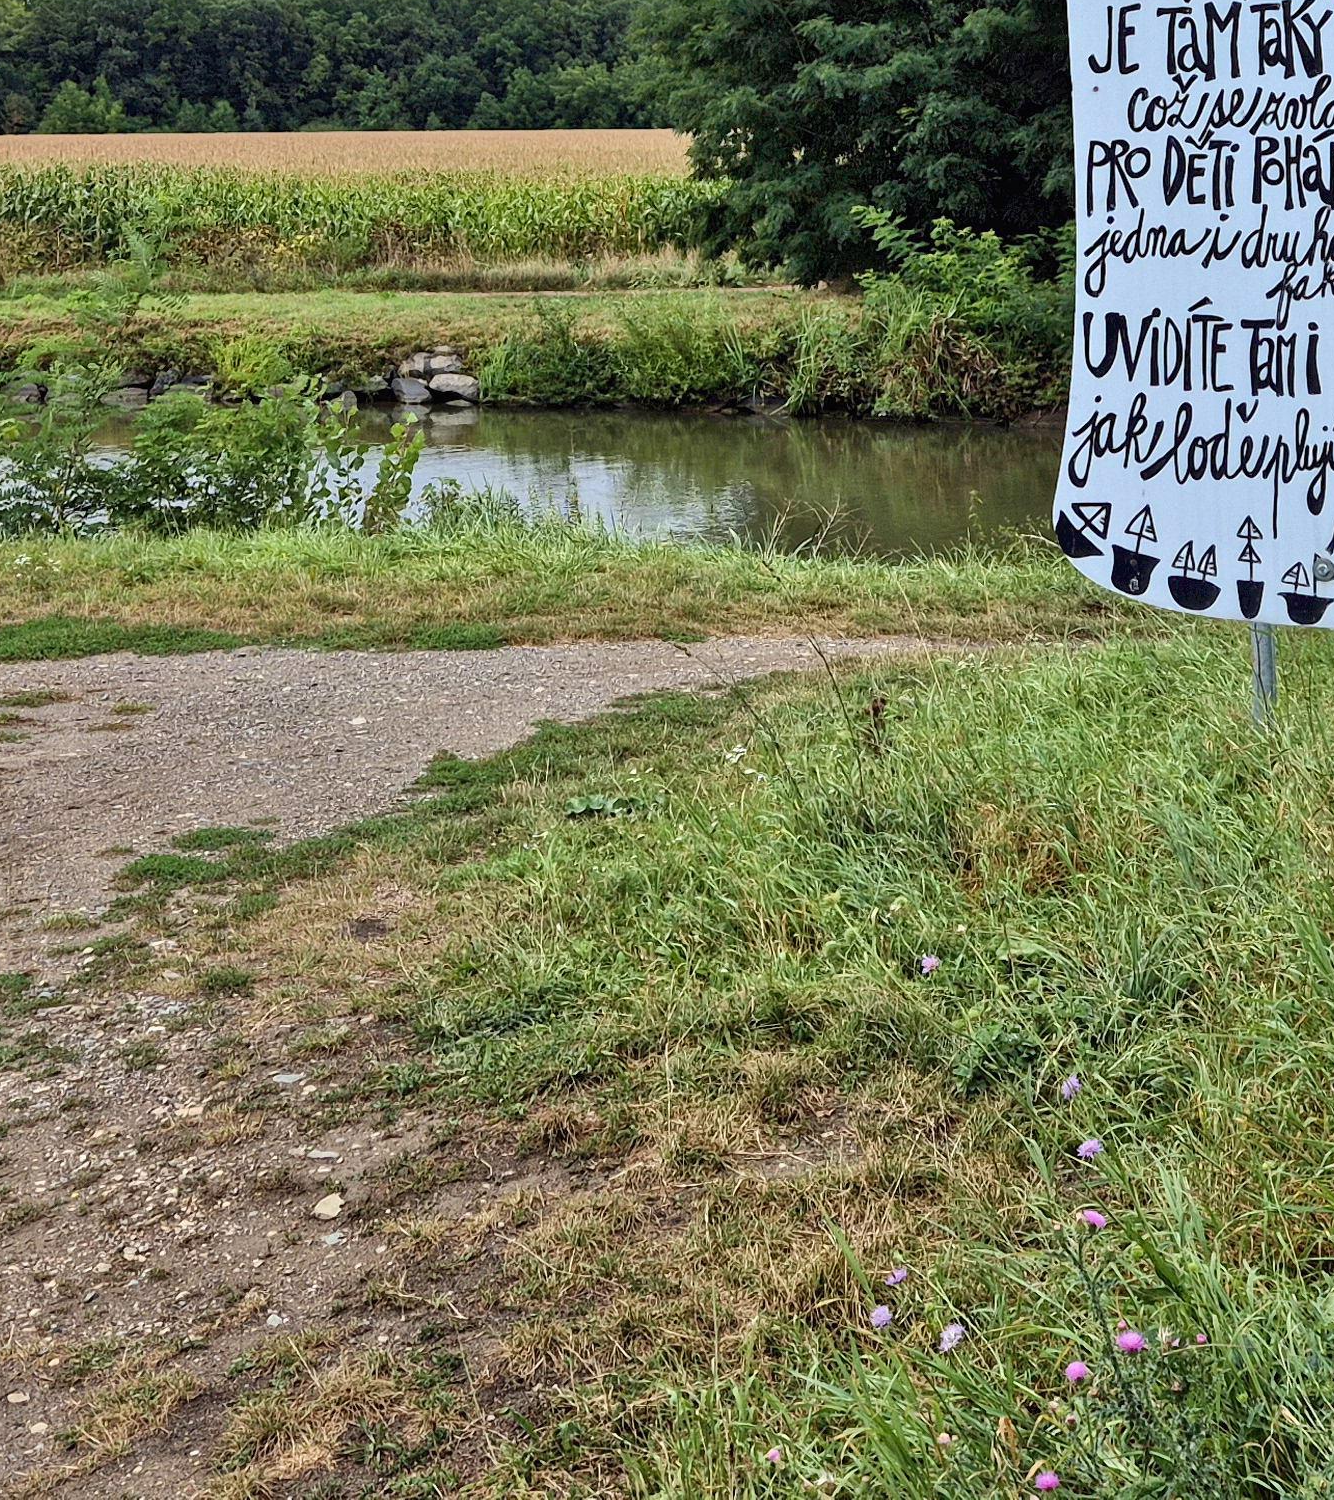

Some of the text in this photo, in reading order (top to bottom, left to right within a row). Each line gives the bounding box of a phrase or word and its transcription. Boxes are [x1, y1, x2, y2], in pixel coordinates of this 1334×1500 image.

[1088, 3, 1141, 75] JE
[1127, 74, 1210, 132] což
[1201, 87, 1263, 140] se
[1087, 139, 1151, 218] PRO
[1084, 207, 1212, 298] jedna
[1201, 212, 1242, 269] i
[1067, 392, 1165, 488] jak
[1140, 398, 1270, 485] lodě
